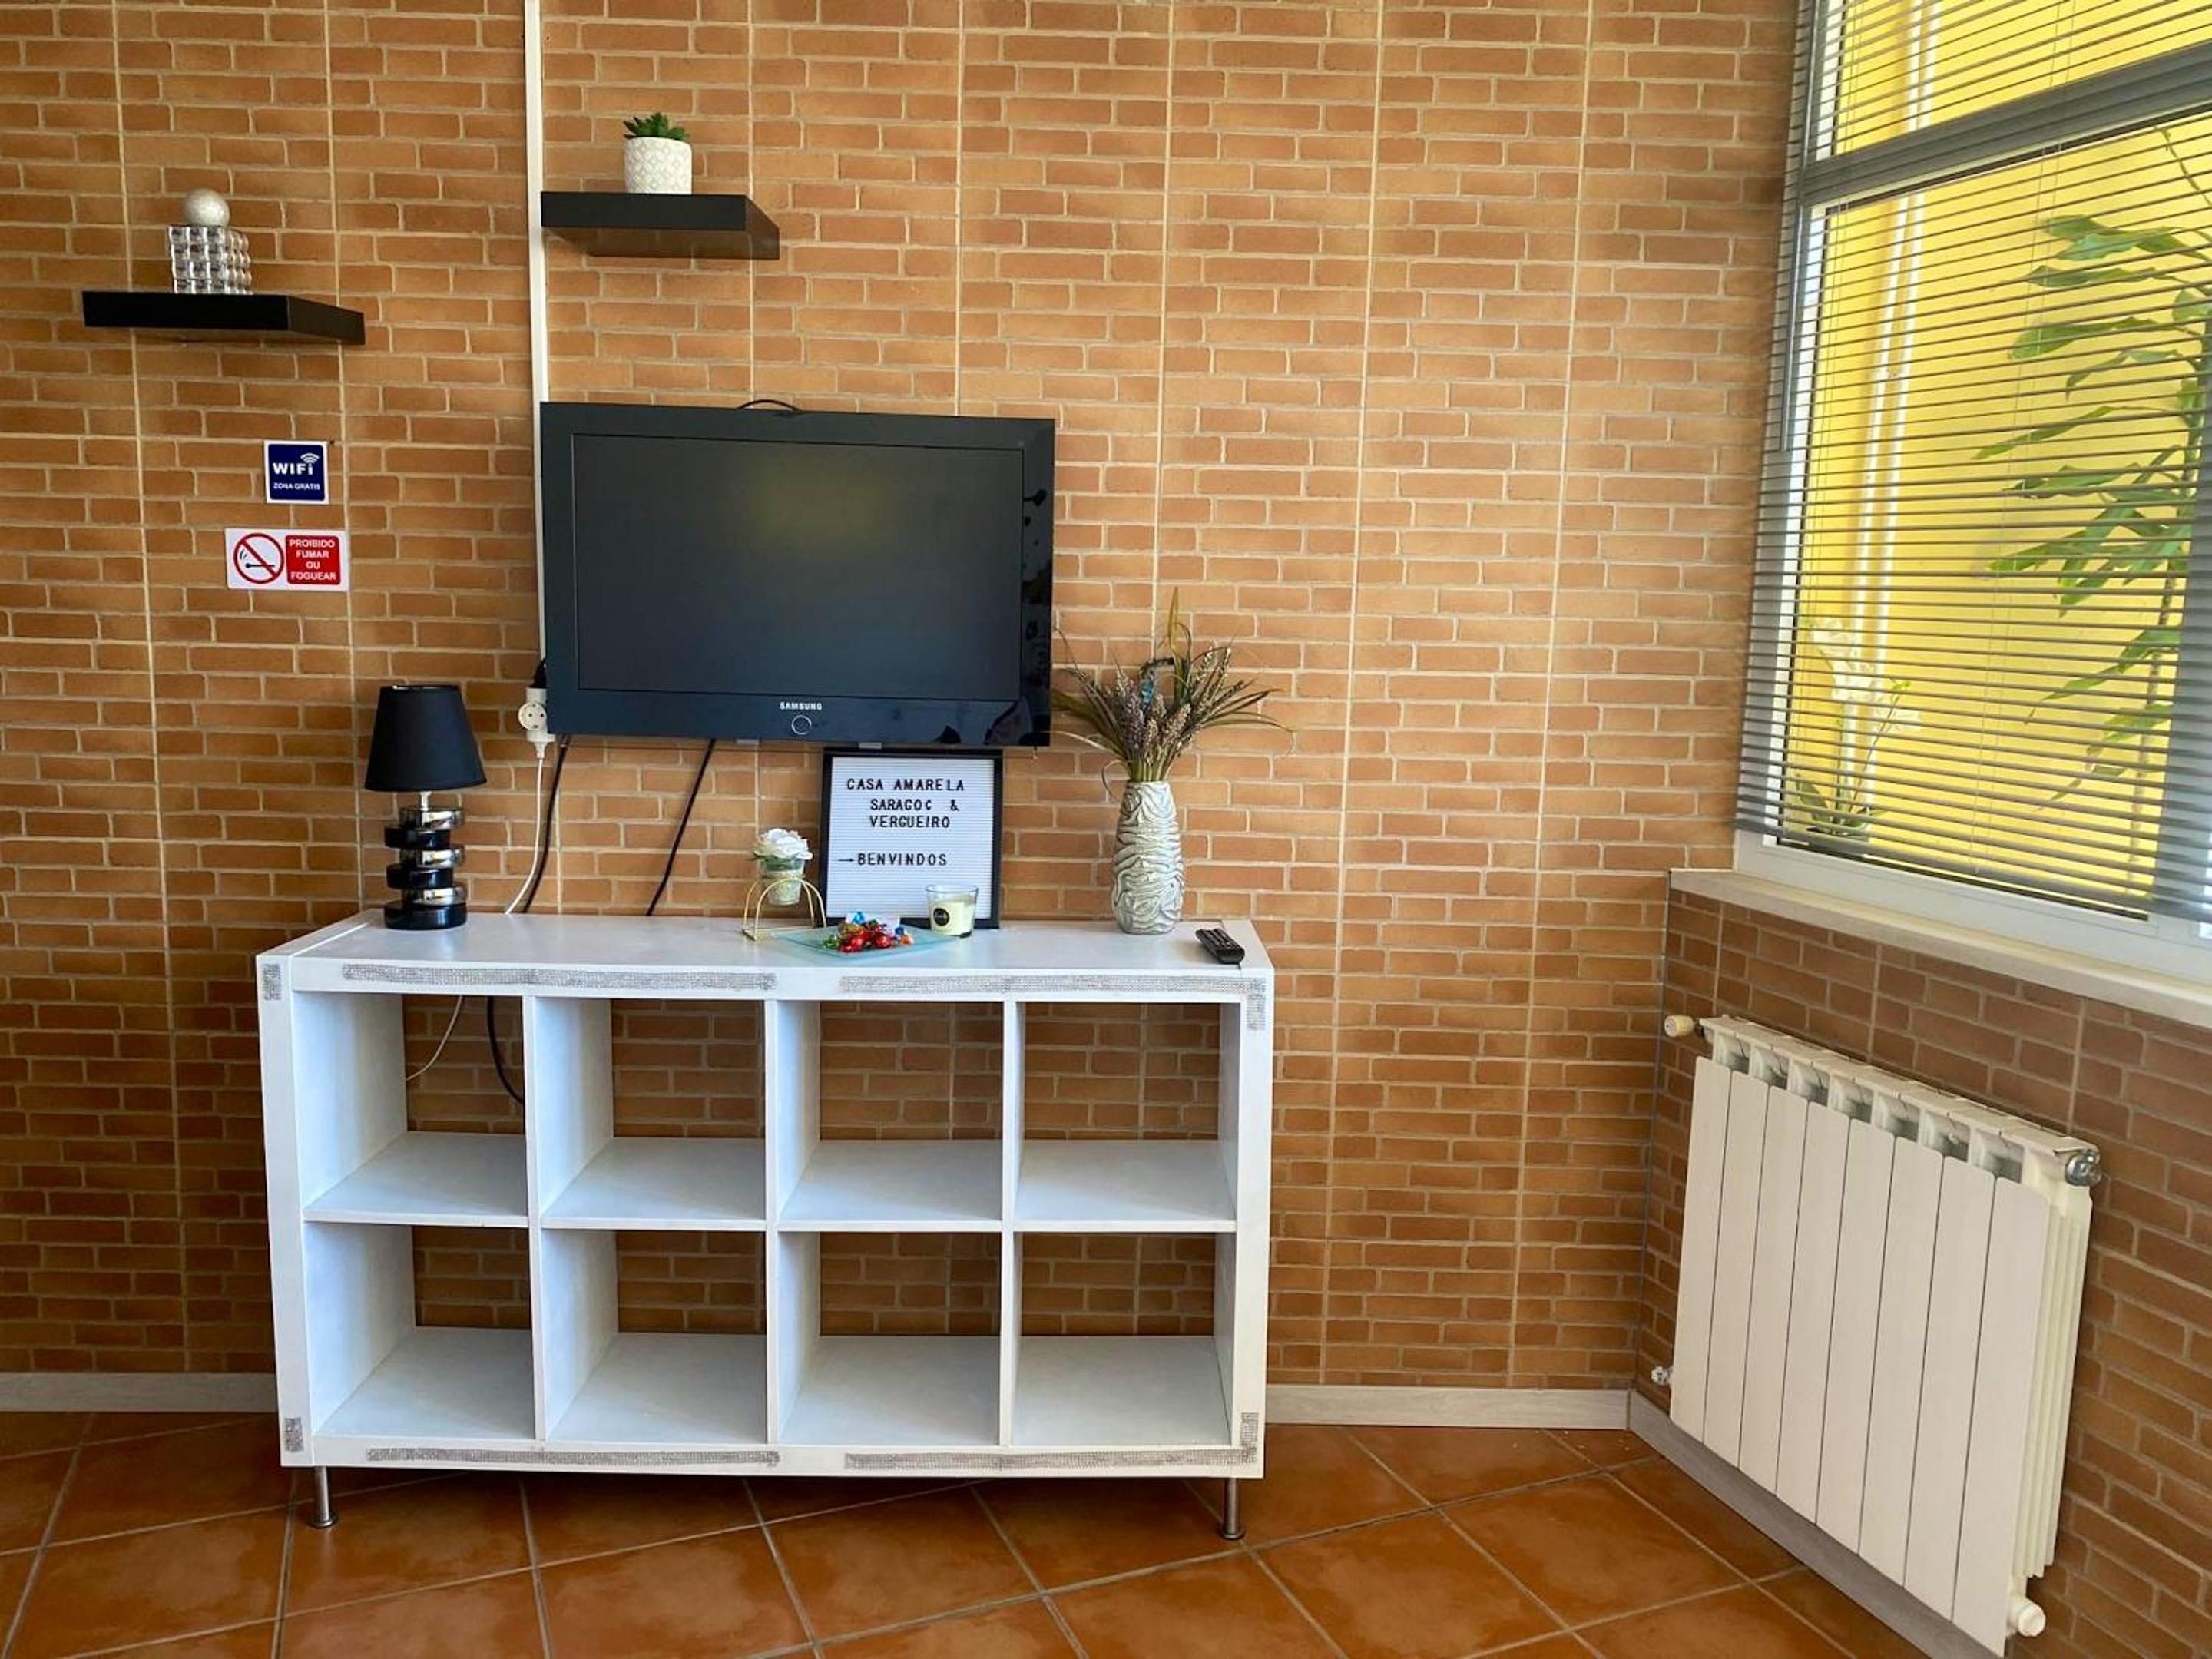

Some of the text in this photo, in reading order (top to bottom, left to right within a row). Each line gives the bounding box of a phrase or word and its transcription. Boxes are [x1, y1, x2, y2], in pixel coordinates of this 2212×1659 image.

[289, 539, 336, 548] PROIBIDO
[296, 550, 329, 558] FUMAR
[290, 571, 336, 580] FOGUEAR
[780, 701, 822, 710] SAMSUNG
[846, 778, 965, 791] CASA AMARELA
[950, 799, 960, 811] &
[869, 815, 950, 828] VERGUEIRO
[857, 853, 947, 866] BENVINDOS
